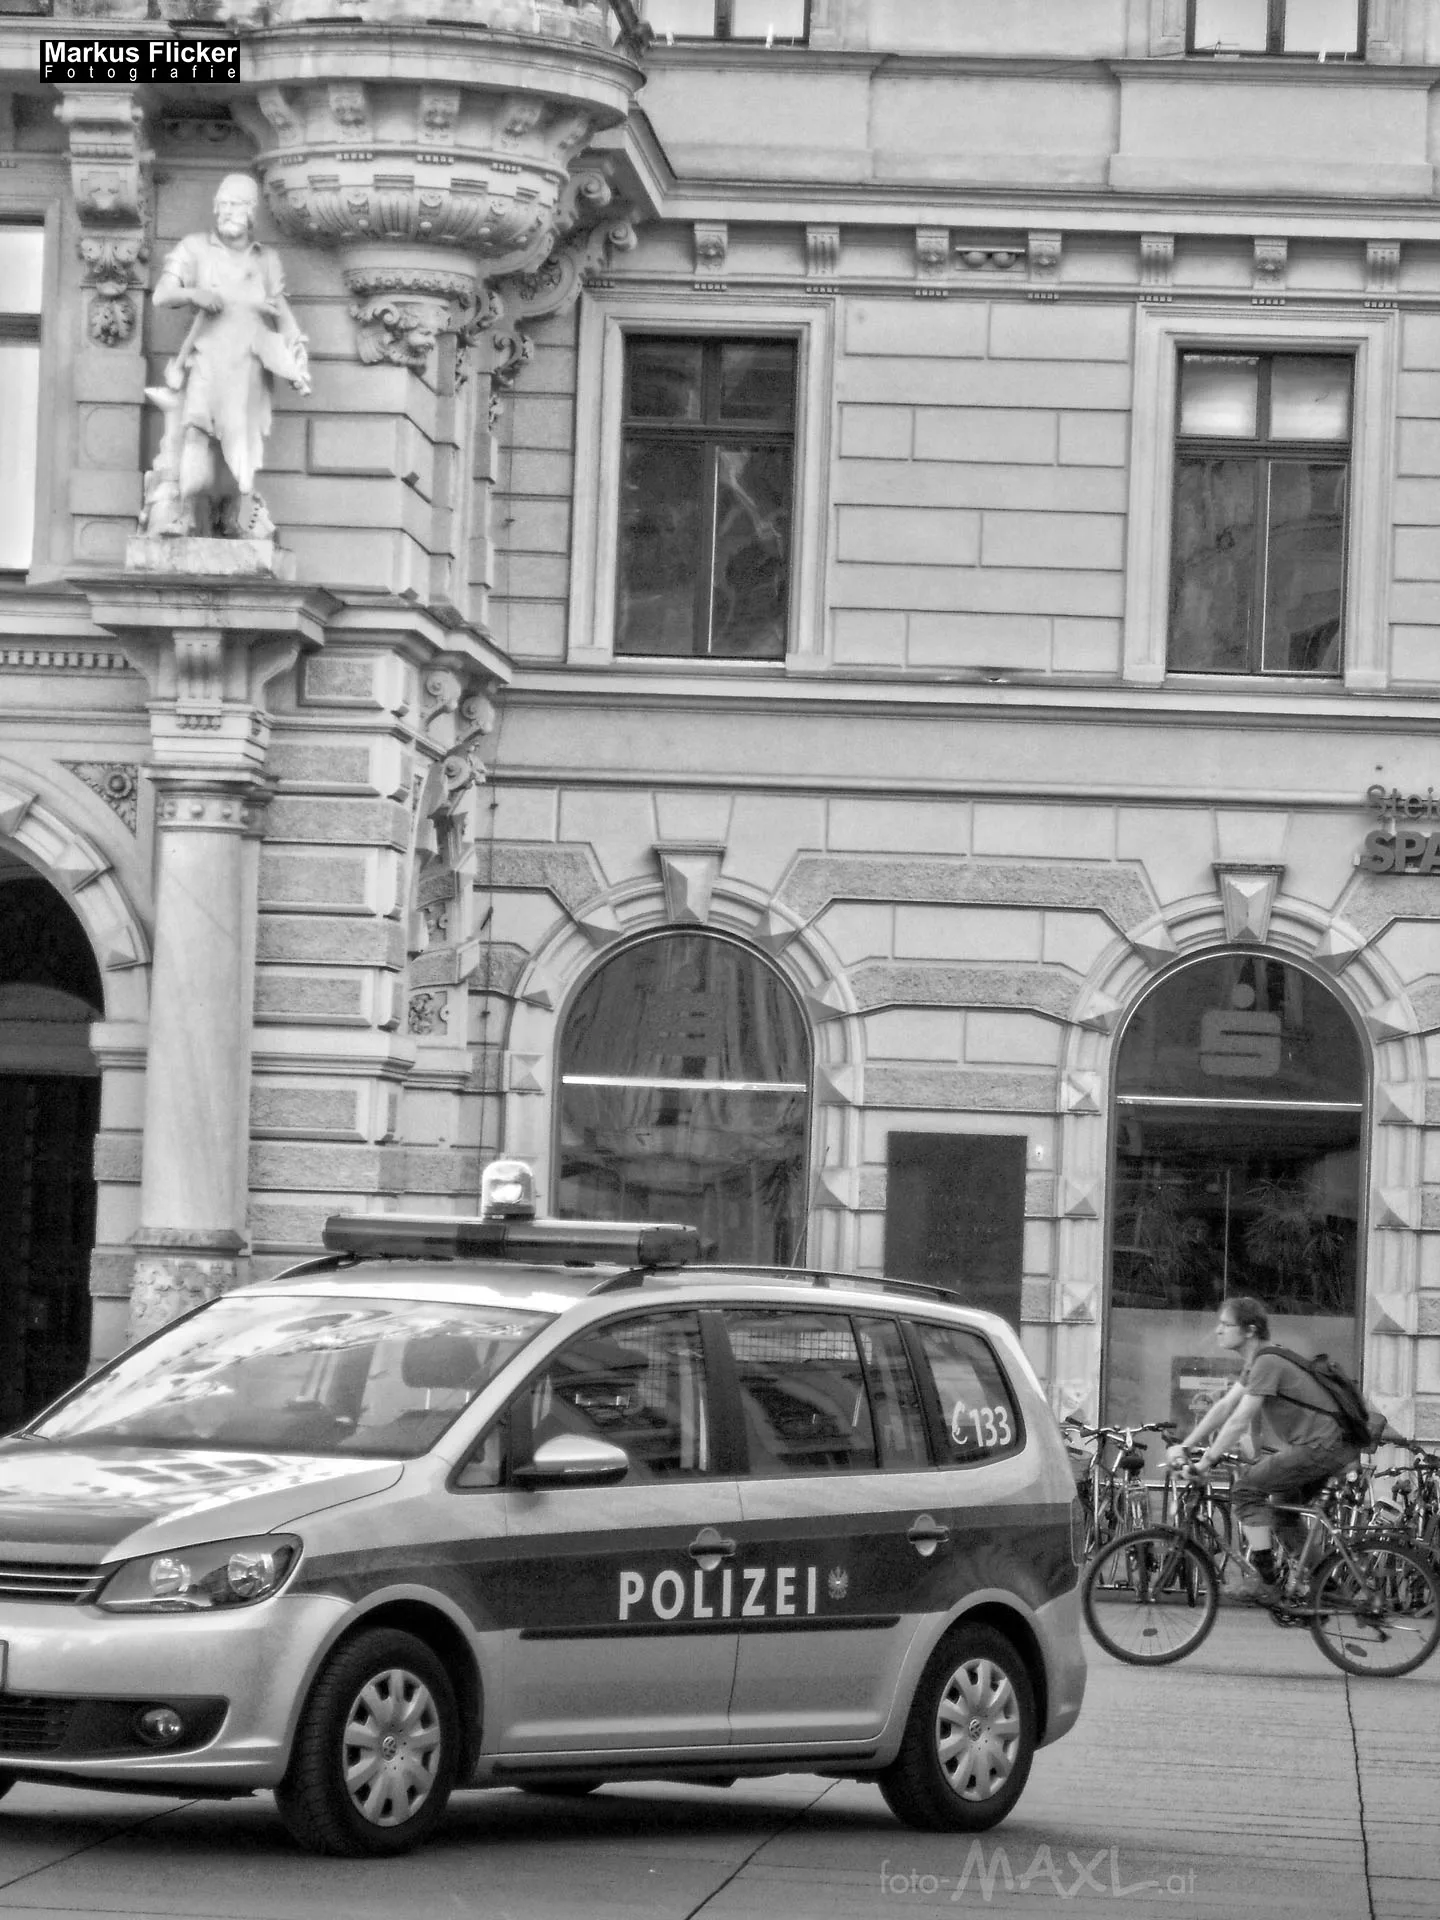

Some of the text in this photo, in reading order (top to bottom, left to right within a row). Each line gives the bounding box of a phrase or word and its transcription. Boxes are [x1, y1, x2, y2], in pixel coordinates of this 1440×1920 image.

[1367, 784, 1440, 819] Stei
[969, 1405, 1012, 1447] 133
[619, 1566, 817, 1621] POLIZEI
